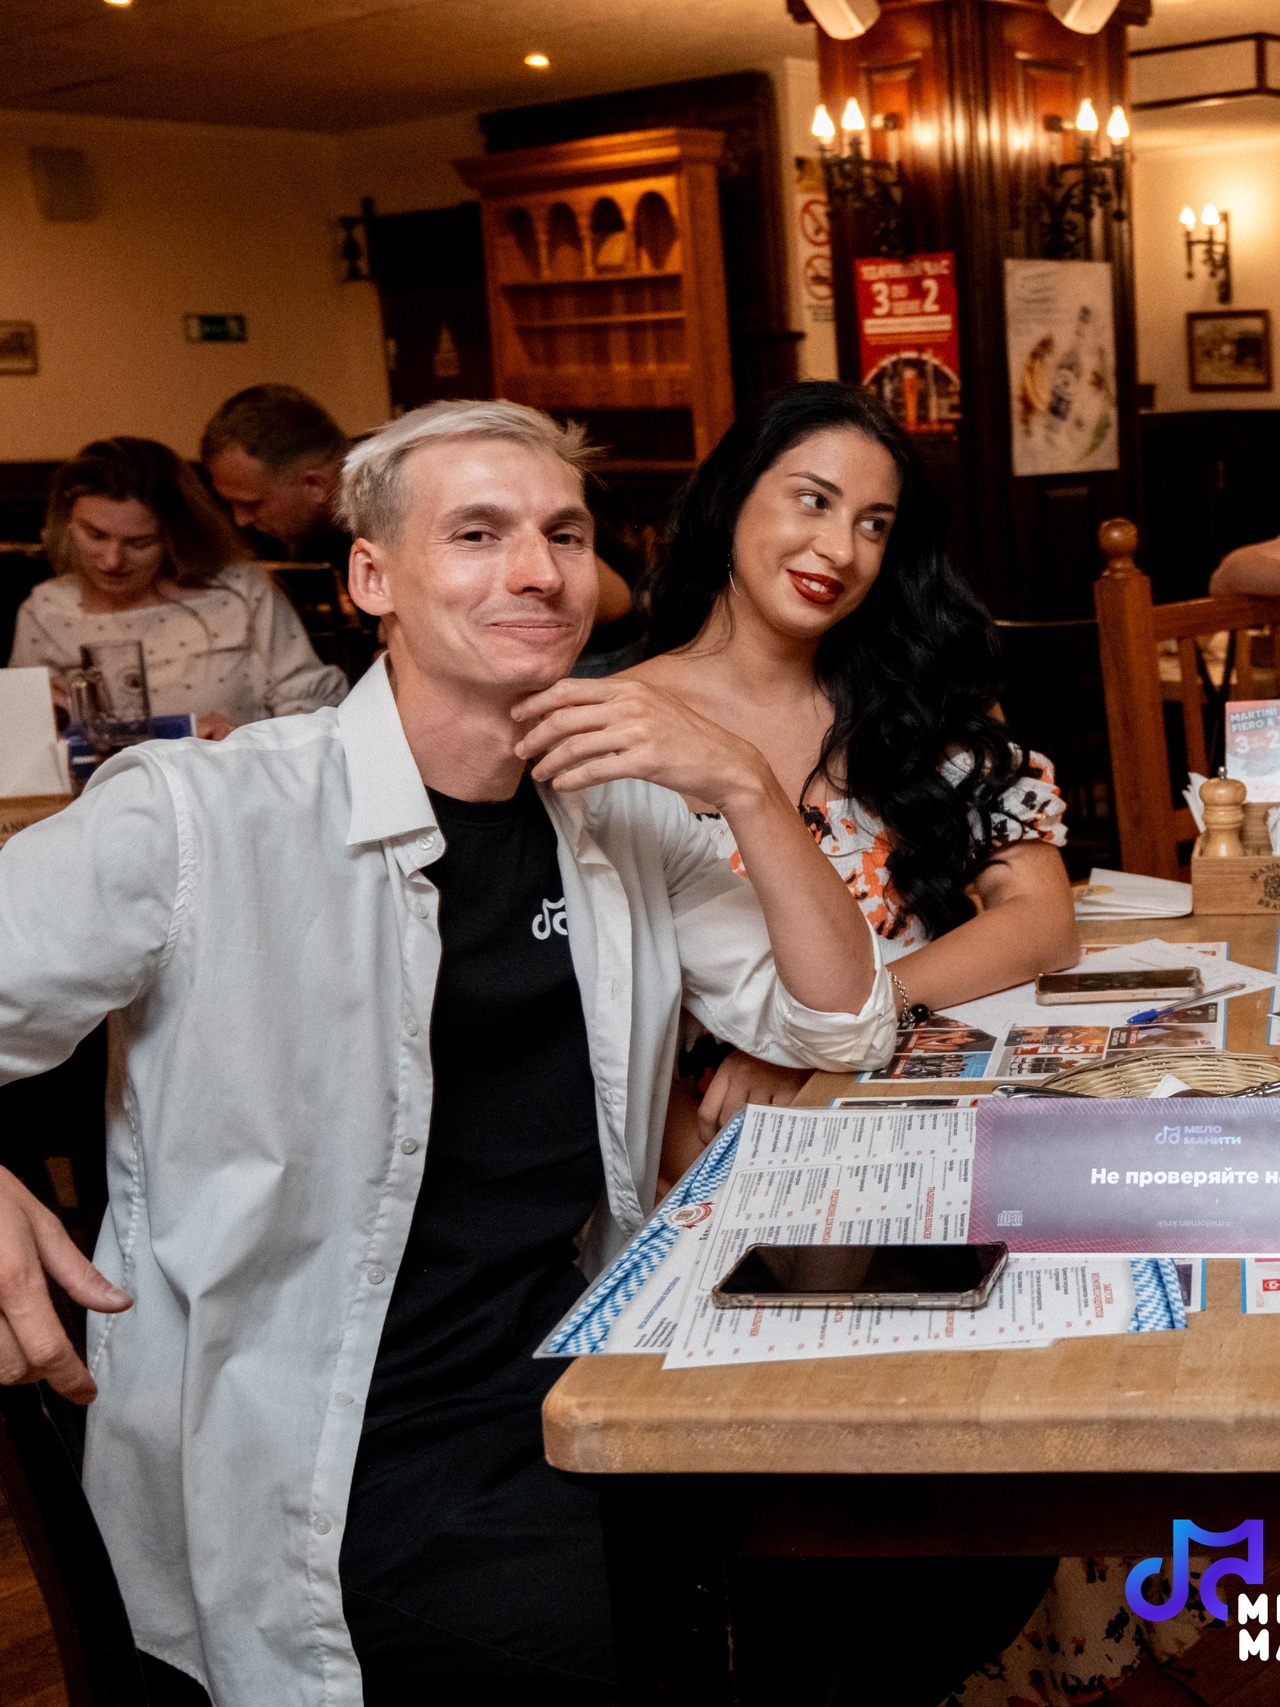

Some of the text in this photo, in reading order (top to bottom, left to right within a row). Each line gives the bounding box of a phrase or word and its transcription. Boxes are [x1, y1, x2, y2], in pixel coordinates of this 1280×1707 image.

[872, 282, 890, 315] 3
[921, 277, 940, 312] 2
[1230, 706, 1278, 723] MARTINI
[1231, 718, 1264, 733] FIERO
[1267, 718, 1275, 727] &
[1235, 735, 1250, 753] 3
[1266, 730, 1280, 748] 2
[1184, 1125, 1222, 1134] МЕЛО
[1184, 1136, 1241, 1145] МАНИТИ
[1090, 1168, 1120, 1184] Не
[1126, 1167, 1259, 1187] проверяйте
